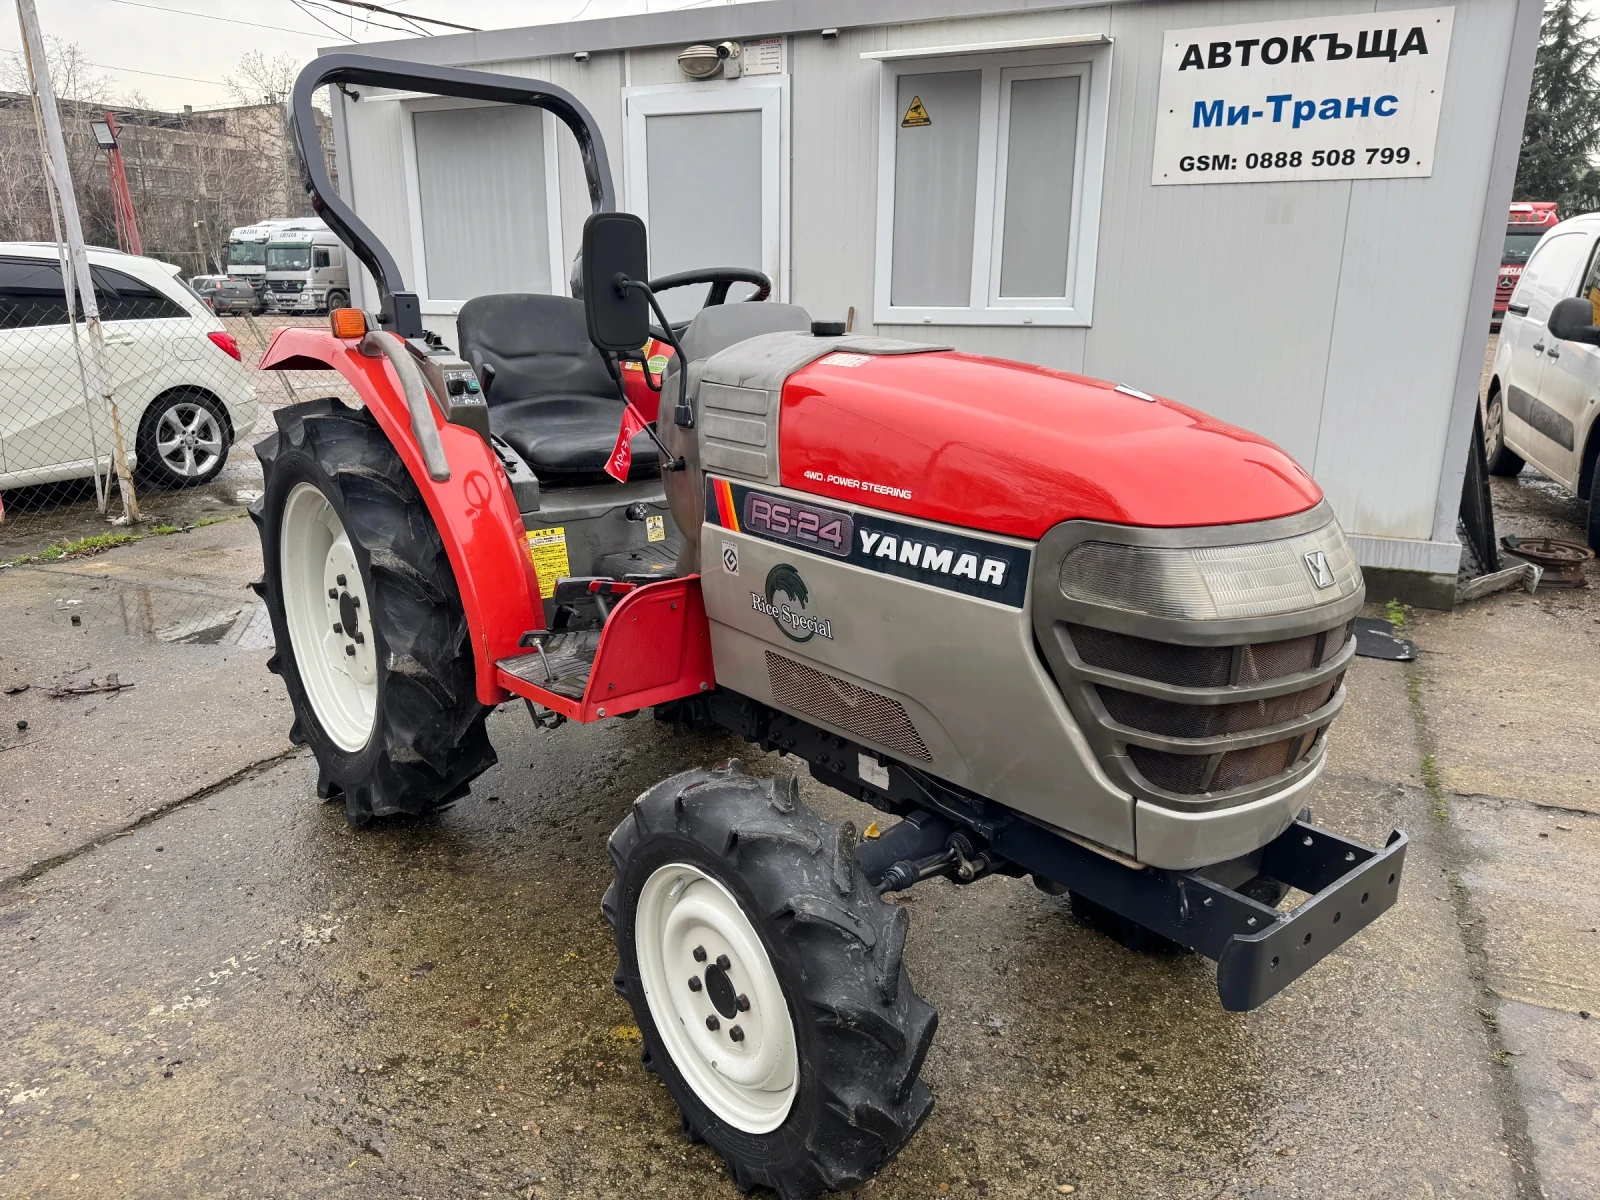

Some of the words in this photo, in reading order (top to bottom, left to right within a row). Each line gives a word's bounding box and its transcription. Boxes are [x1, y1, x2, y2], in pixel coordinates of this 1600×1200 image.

[1178, 26, 1429, 71] АВТОКЪЩА
[1192, 94, 1399, 129] Ми-Транс
[1179, 154, 1237, 172] GSM:
[1245, 151, 1303, 169] 0888
[1311, 149, 1356, 167] 508
[1365, 146, 1411, 165] 799
[827, 474, 860, 489] POWER
[861, 481, 912, 500] STEERING
[751, 498, 842, 549] RS-24
[859, 530, 1007, 586] YANMAR
[750, 592, 780, 618] Rice
[781, 603, 833, 639] Special
